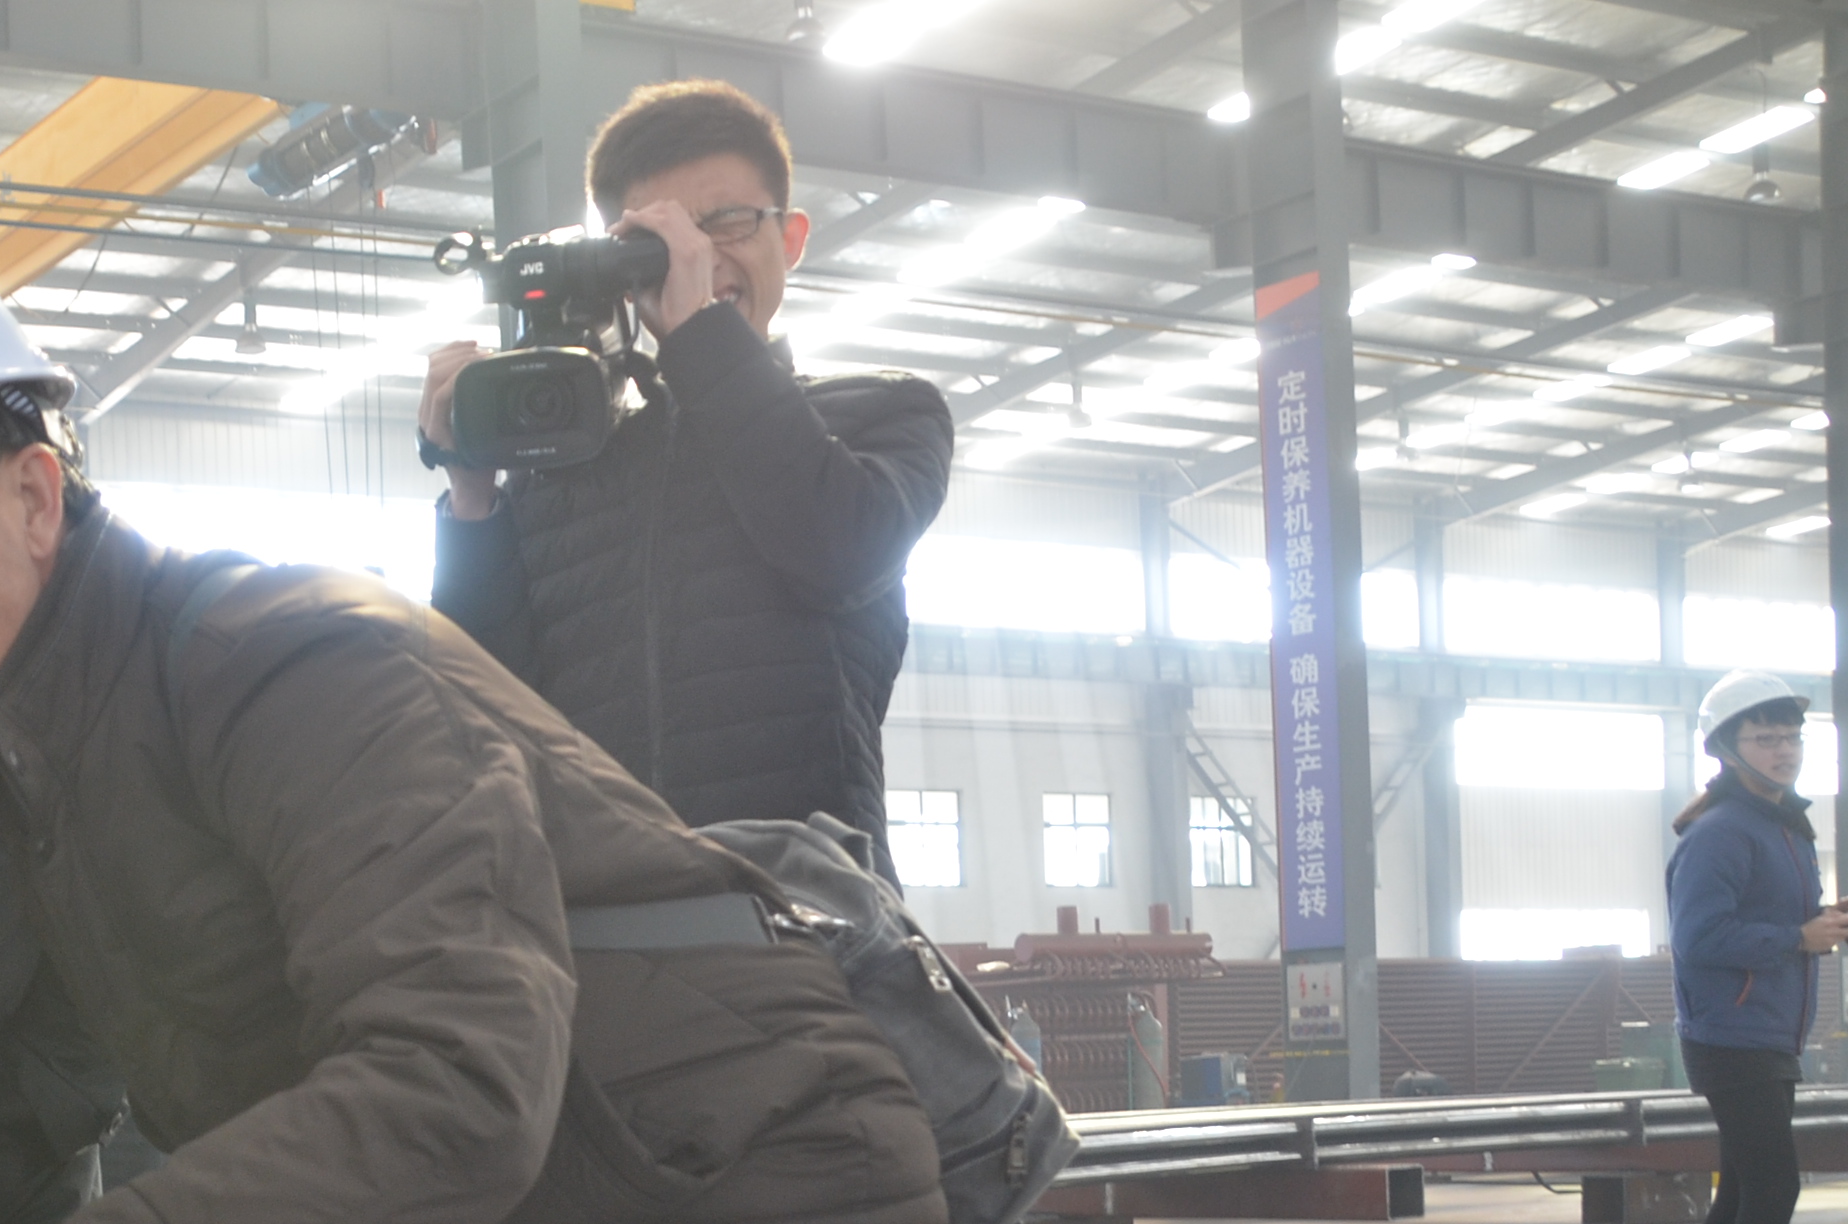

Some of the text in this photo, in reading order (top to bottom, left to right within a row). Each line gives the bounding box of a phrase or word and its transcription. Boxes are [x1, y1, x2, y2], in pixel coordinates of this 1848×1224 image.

[520, 262, 544, 276] JVC
[1277, 369, 1317, 636] 定时保养机器设备
[1289, 653, 1327, 918] 确保生产持续运转
